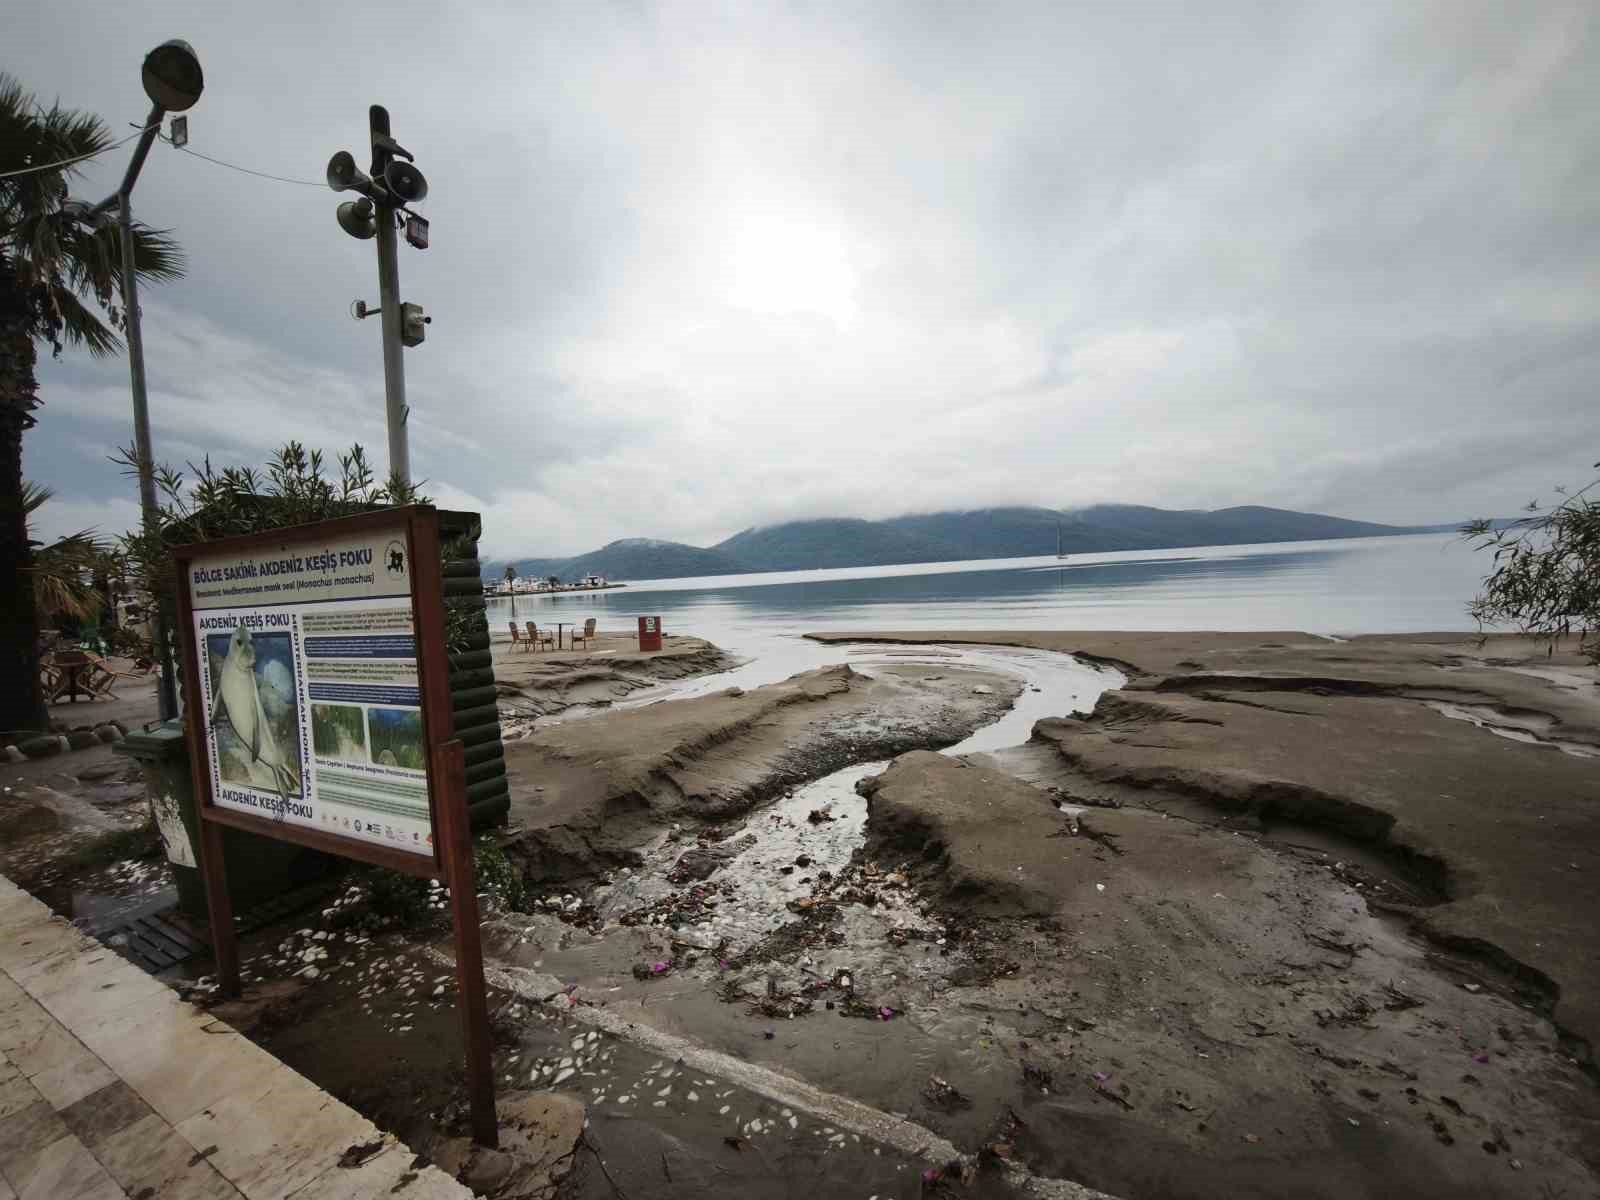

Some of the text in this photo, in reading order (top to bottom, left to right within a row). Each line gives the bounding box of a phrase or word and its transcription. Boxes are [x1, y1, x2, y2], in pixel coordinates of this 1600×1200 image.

[193, 567, 223, 584] BÖLGE
[259, 554, 303, 577] AKDENİZ
[305, 549, 338, 574] KEŞİŞ
[339, 548, 373, 567] FOKU
[199, 612, 238, 629] AKDENİZ
[239, 611, 264, 630] KEŞİŞ
[265, 614, 290, 627] FOKU
[222, 790, 258, 807] AKDENİZ
[287, 801, 313, 818] FOKU
